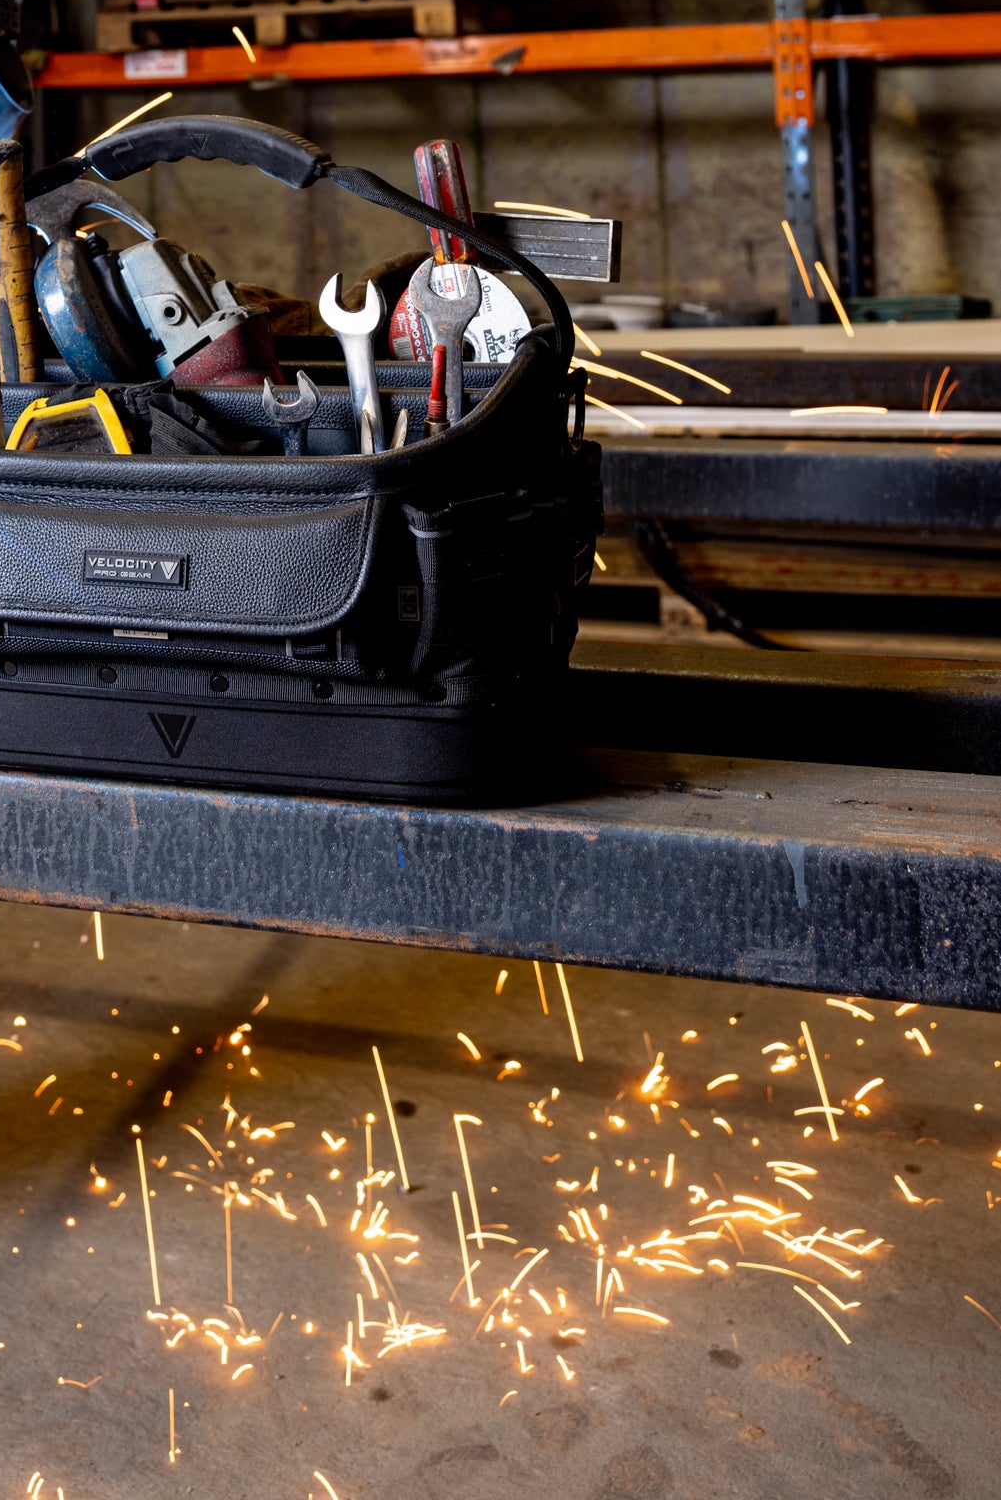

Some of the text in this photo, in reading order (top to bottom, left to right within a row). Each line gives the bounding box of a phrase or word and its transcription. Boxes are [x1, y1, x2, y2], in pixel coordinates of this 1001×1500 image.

[480, 274, 492, 312] 1.0mm
[484, 332, 498, 361] ATLAS
[88, 557, 157, 569] VELOCITY
[93, 569, 152, 579] PRO GEAR
